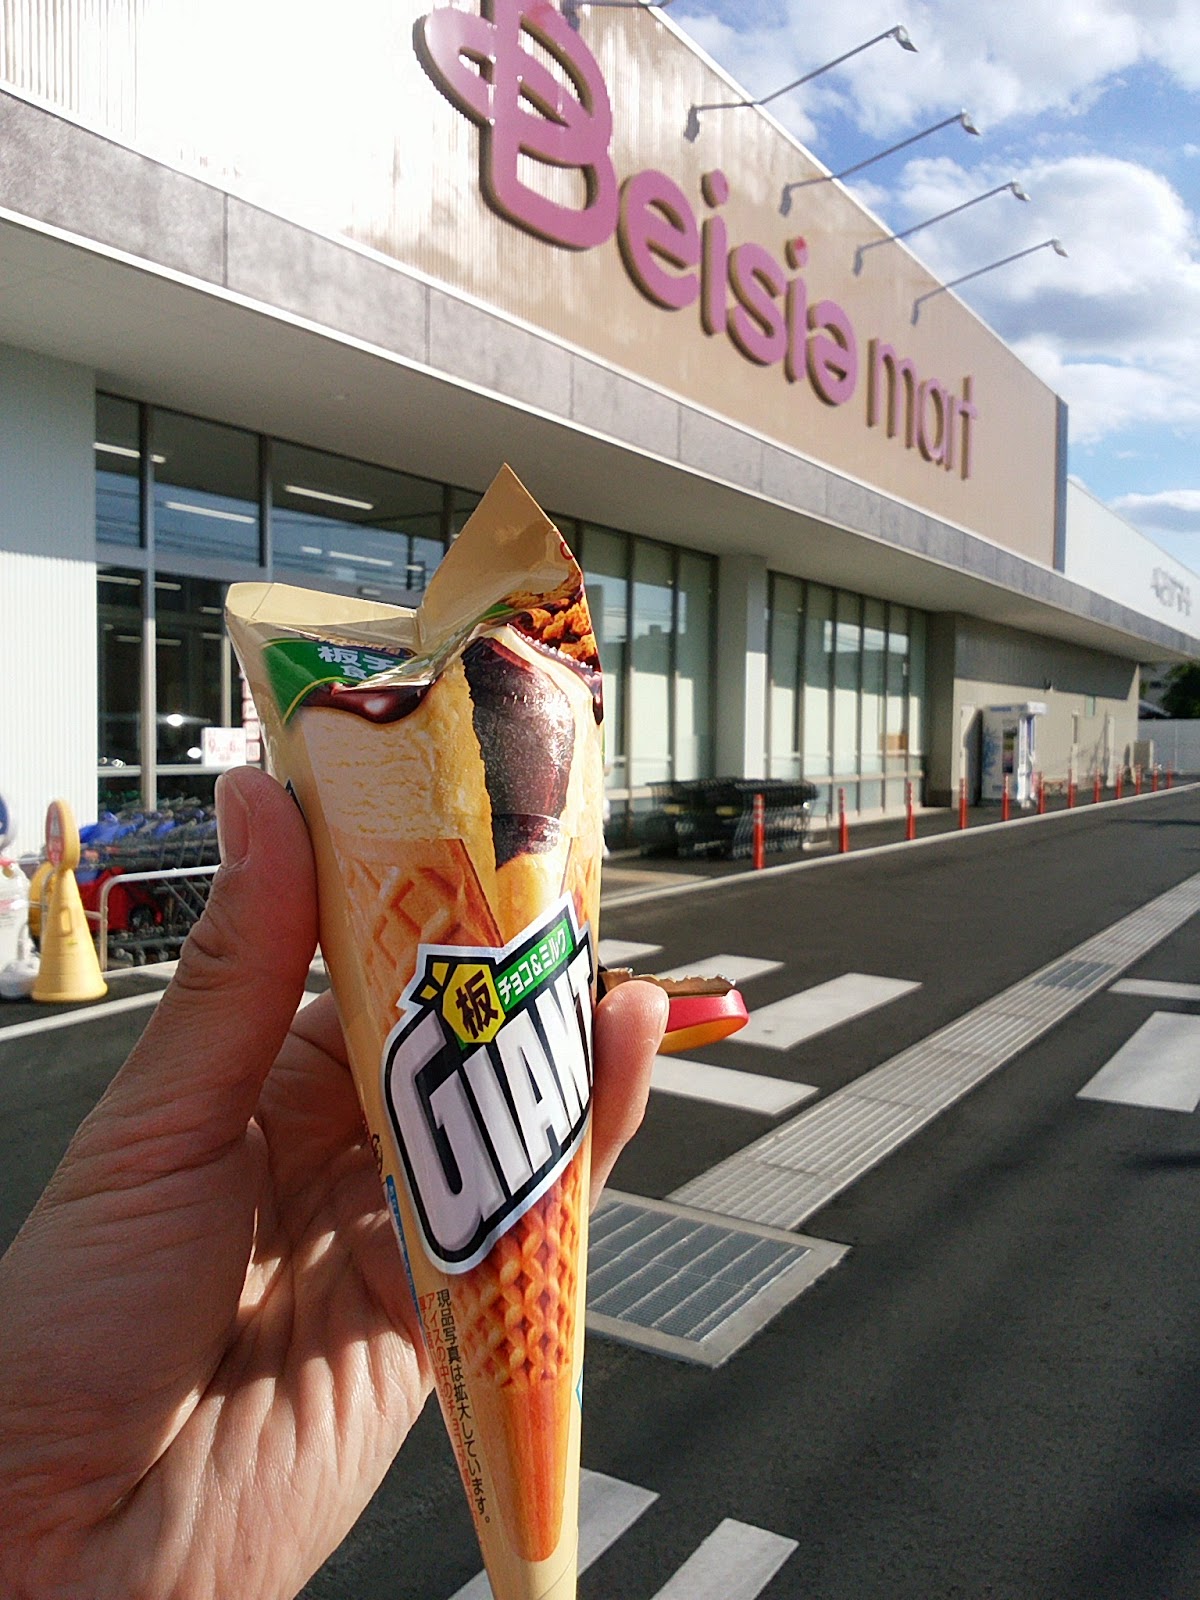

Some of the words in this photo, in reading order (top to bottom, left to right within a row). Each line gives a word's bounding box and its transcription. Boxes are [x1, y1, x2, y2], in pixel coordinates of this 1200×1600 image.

[412, 0, 858, 407] Beisia
[867, 336, 978, 480] mart
[454, 969, 500, 1040] 板
[497, 927, 567, 1005] チョコ&ミルク
[389, 943, 594, 1252] GIANT
[436, 1288, 491, 1524] 現品写真は拡大しています。
